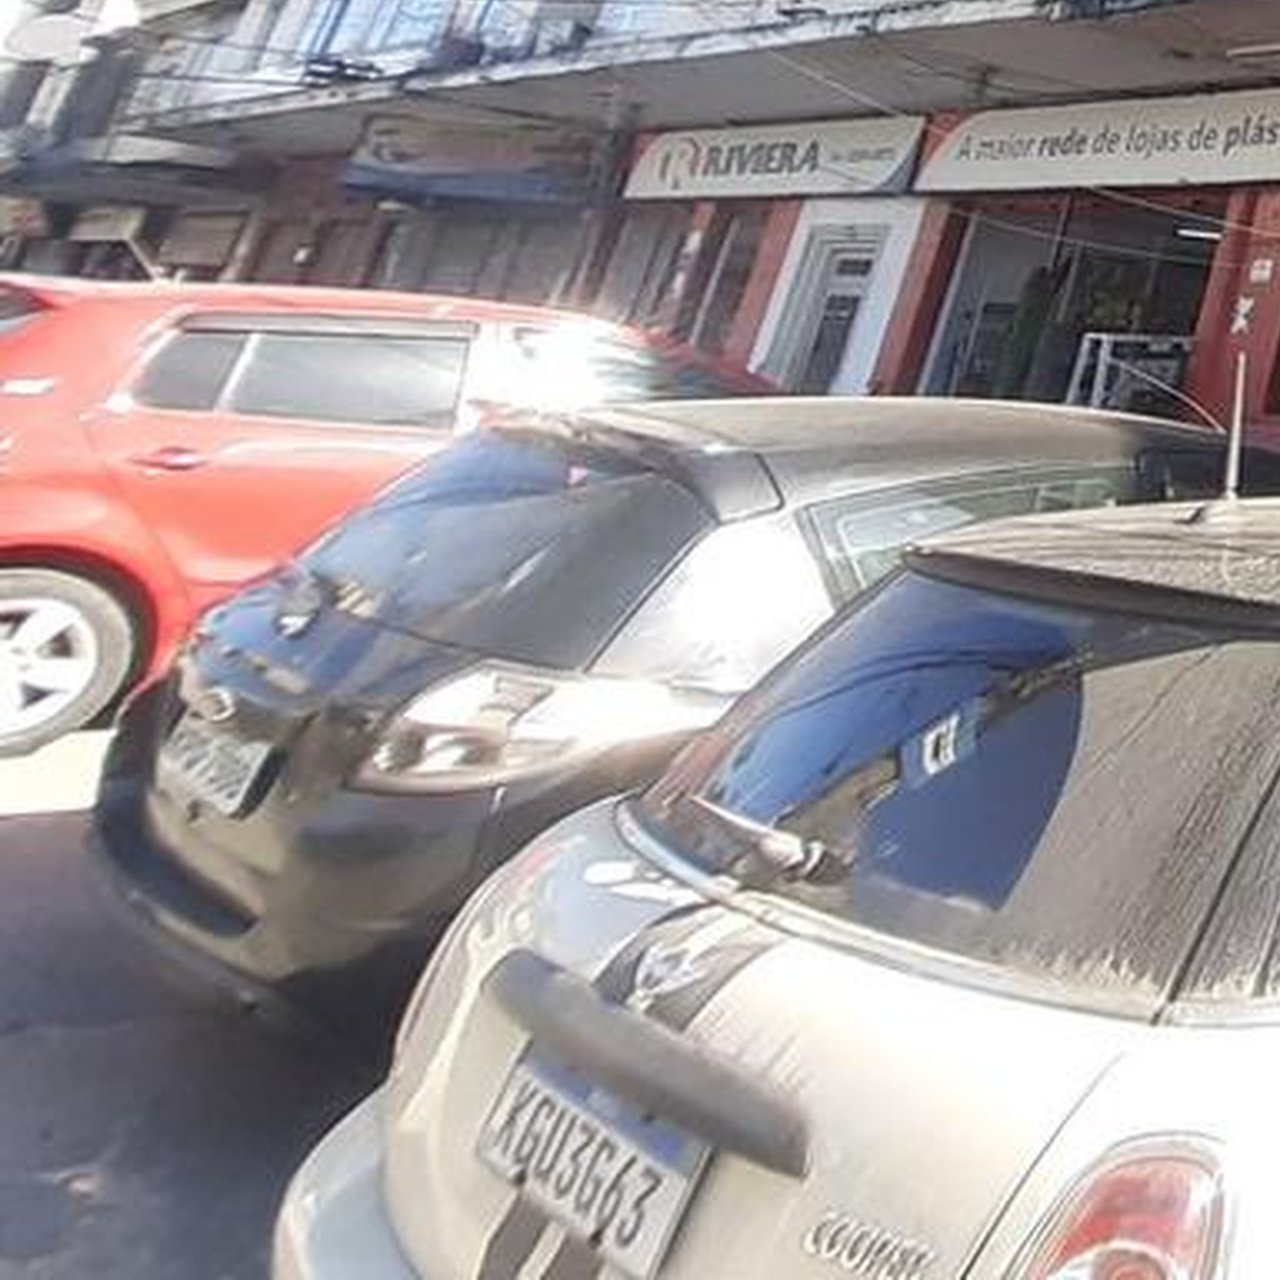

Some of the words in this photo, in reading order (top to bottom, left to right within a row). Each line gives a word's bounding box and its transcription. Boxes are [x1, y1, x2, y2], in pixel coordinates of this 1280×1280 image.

[702, 139, 821, 177] RIVIERA
[1038, 126, 1090, 158] rede
[1092, 123, 1122, 155] de
[1125, 123, 1181, 159] lojas
[1187, 120, 1219, 151] de
